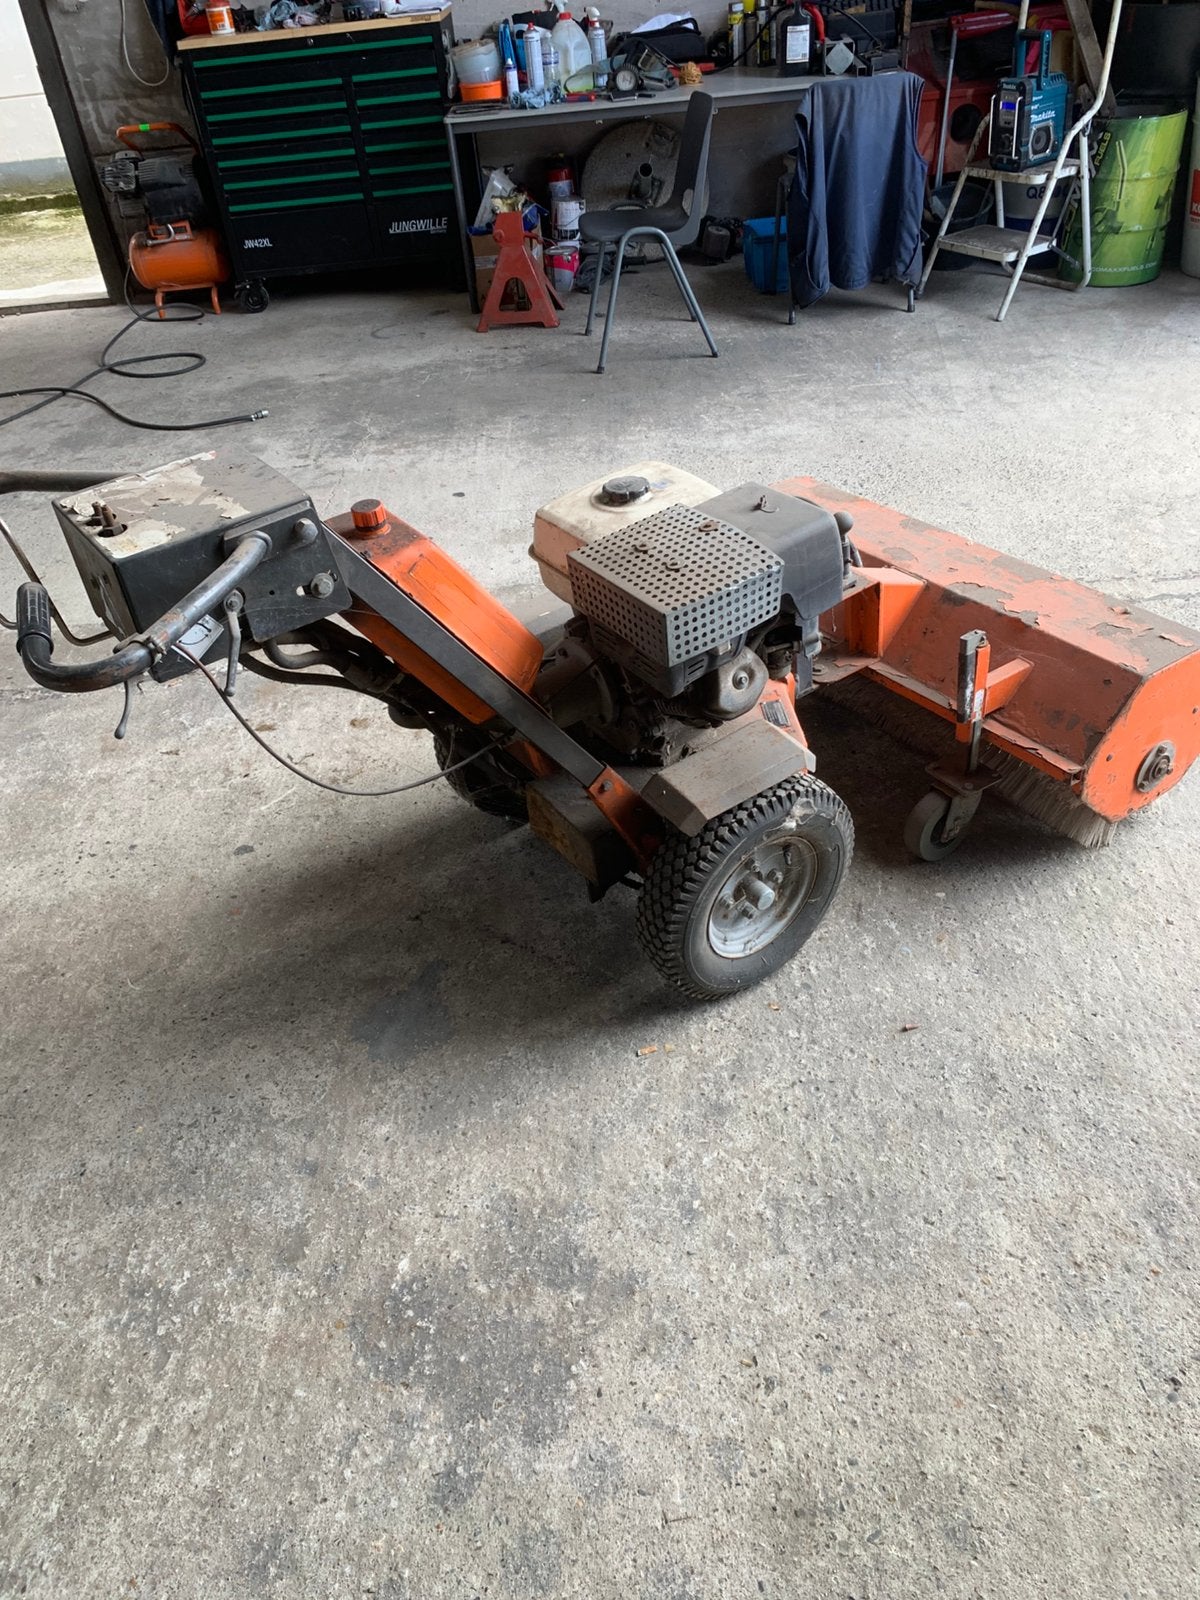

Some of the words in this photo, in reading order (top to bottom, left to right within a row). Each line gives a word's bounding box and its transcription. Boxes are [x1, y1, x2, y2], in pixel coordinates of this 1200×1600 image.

[1094, 132, 1111, 166] FUELS
[389, 217, 448, 234] JUNGWILLE
[243, 238, 272, 249] JW42XL
